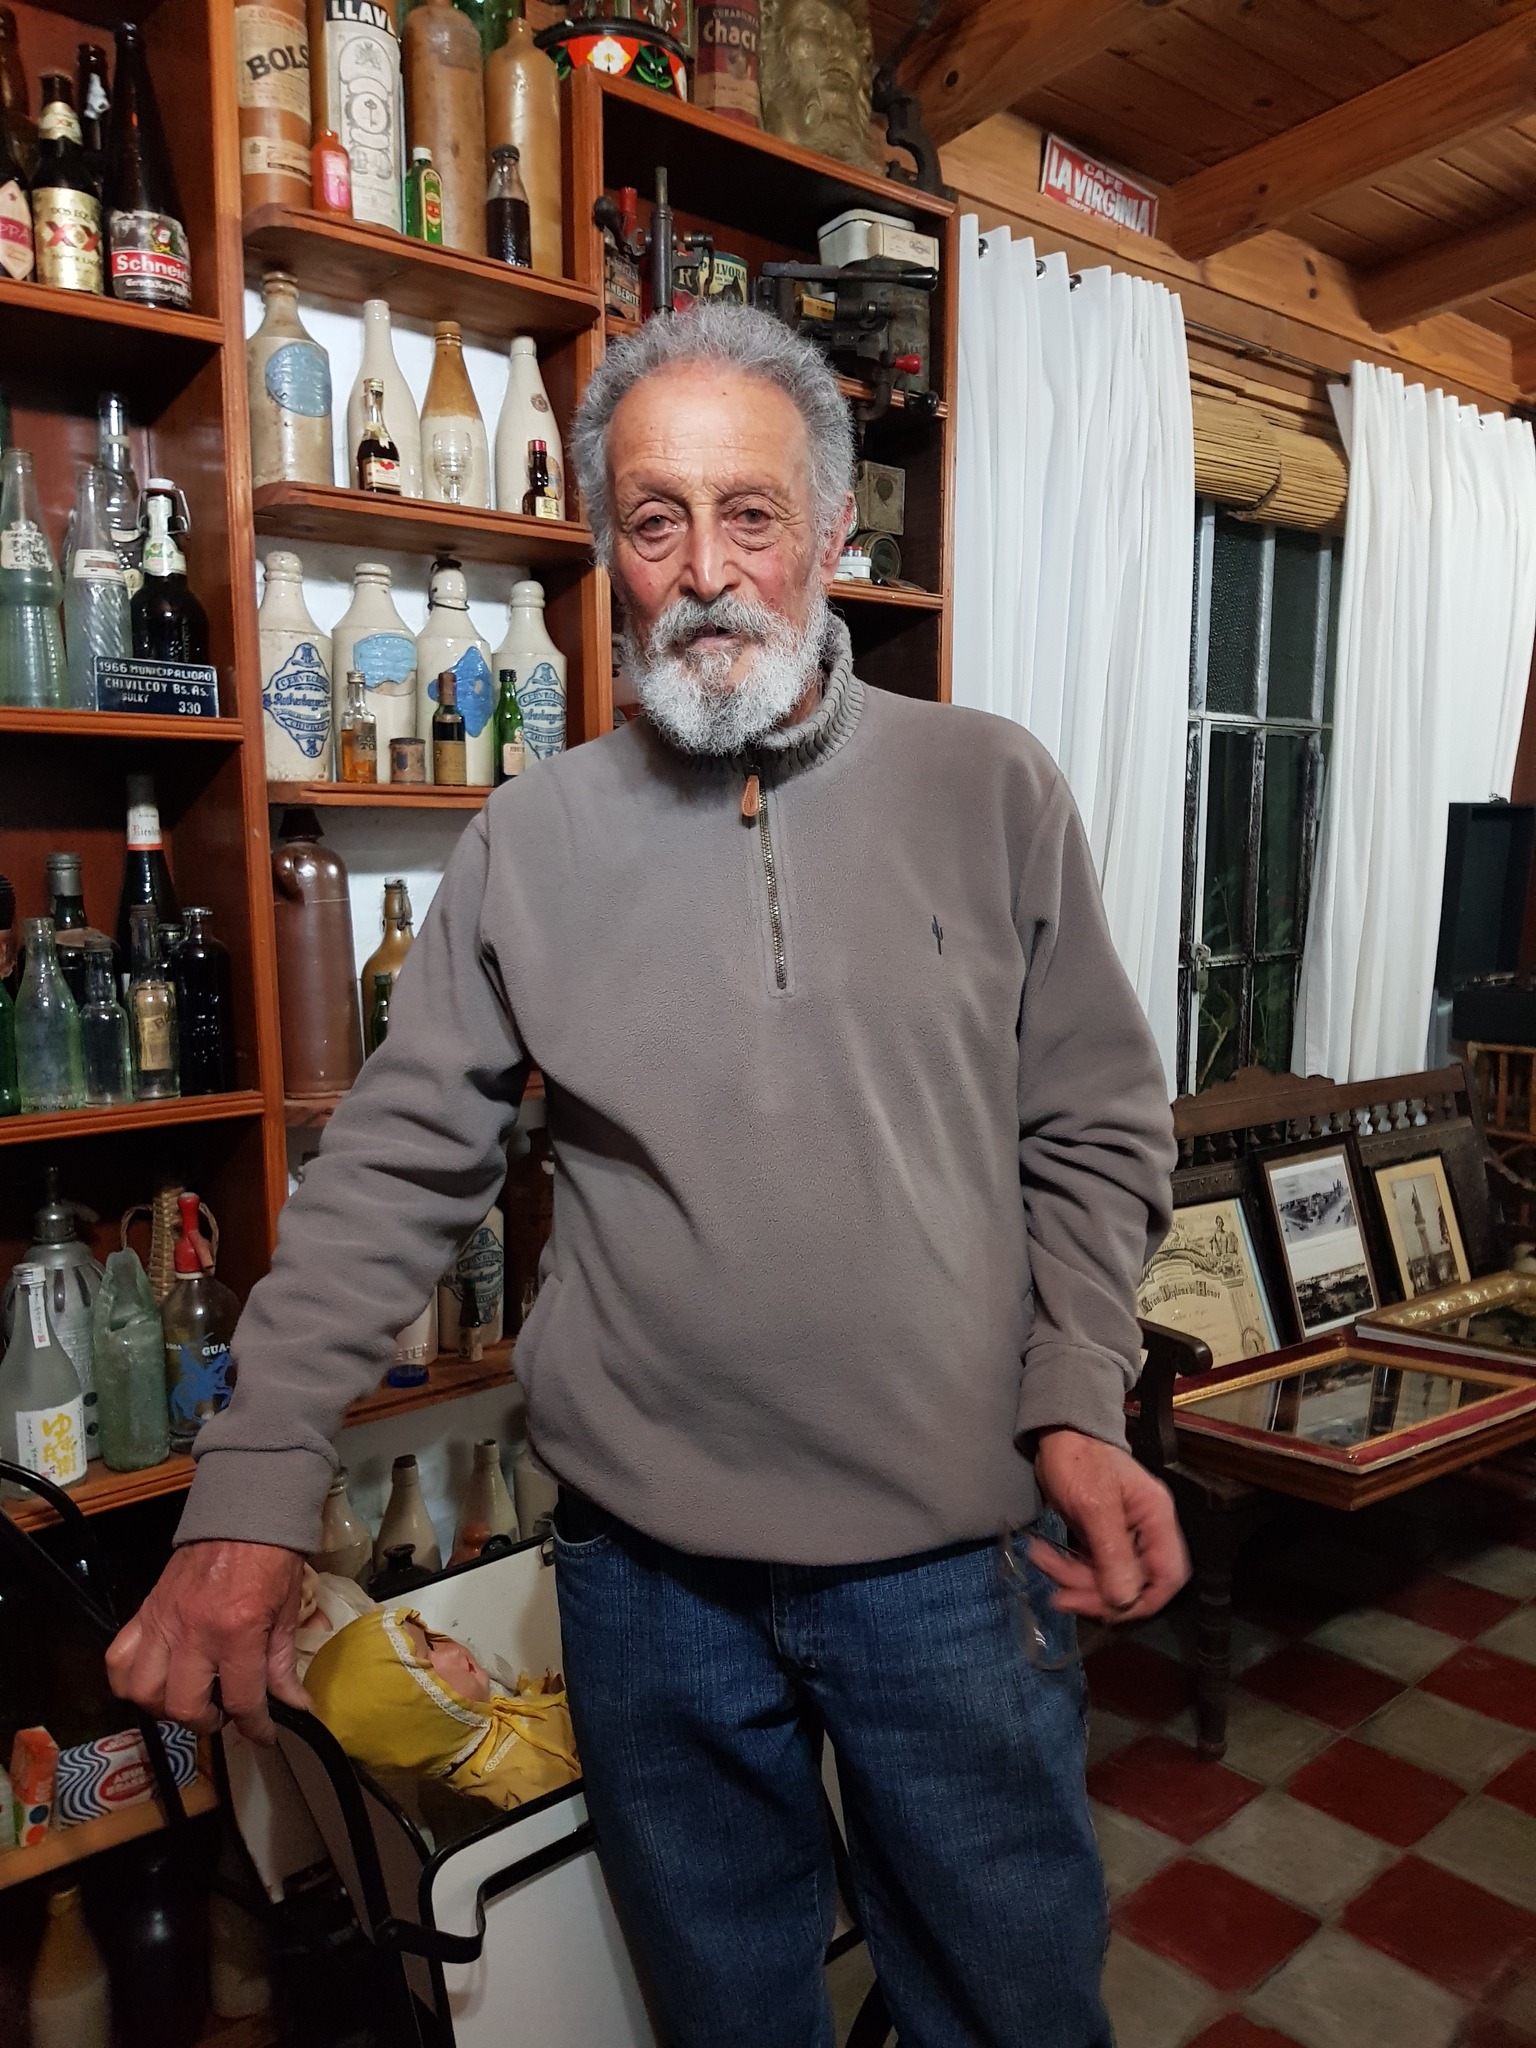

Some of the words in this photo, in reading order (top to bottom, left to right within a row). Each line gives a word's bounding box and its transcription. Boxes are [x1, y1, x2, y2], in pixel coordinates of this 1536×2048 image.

[246, 45, 309, 80] BOLS
[1083, 163, 1124, 192] CAFE
[1048, 145, 1072, 196] LA
[1074, 168, 1150, 237] VIRGINIA
[699, 261, 747, 282] PLVORA
[99, 661, 127, 674] 1966
[105, 678, 167, 693] CHIVILCOY
[178, 701, 201, 715] 330
